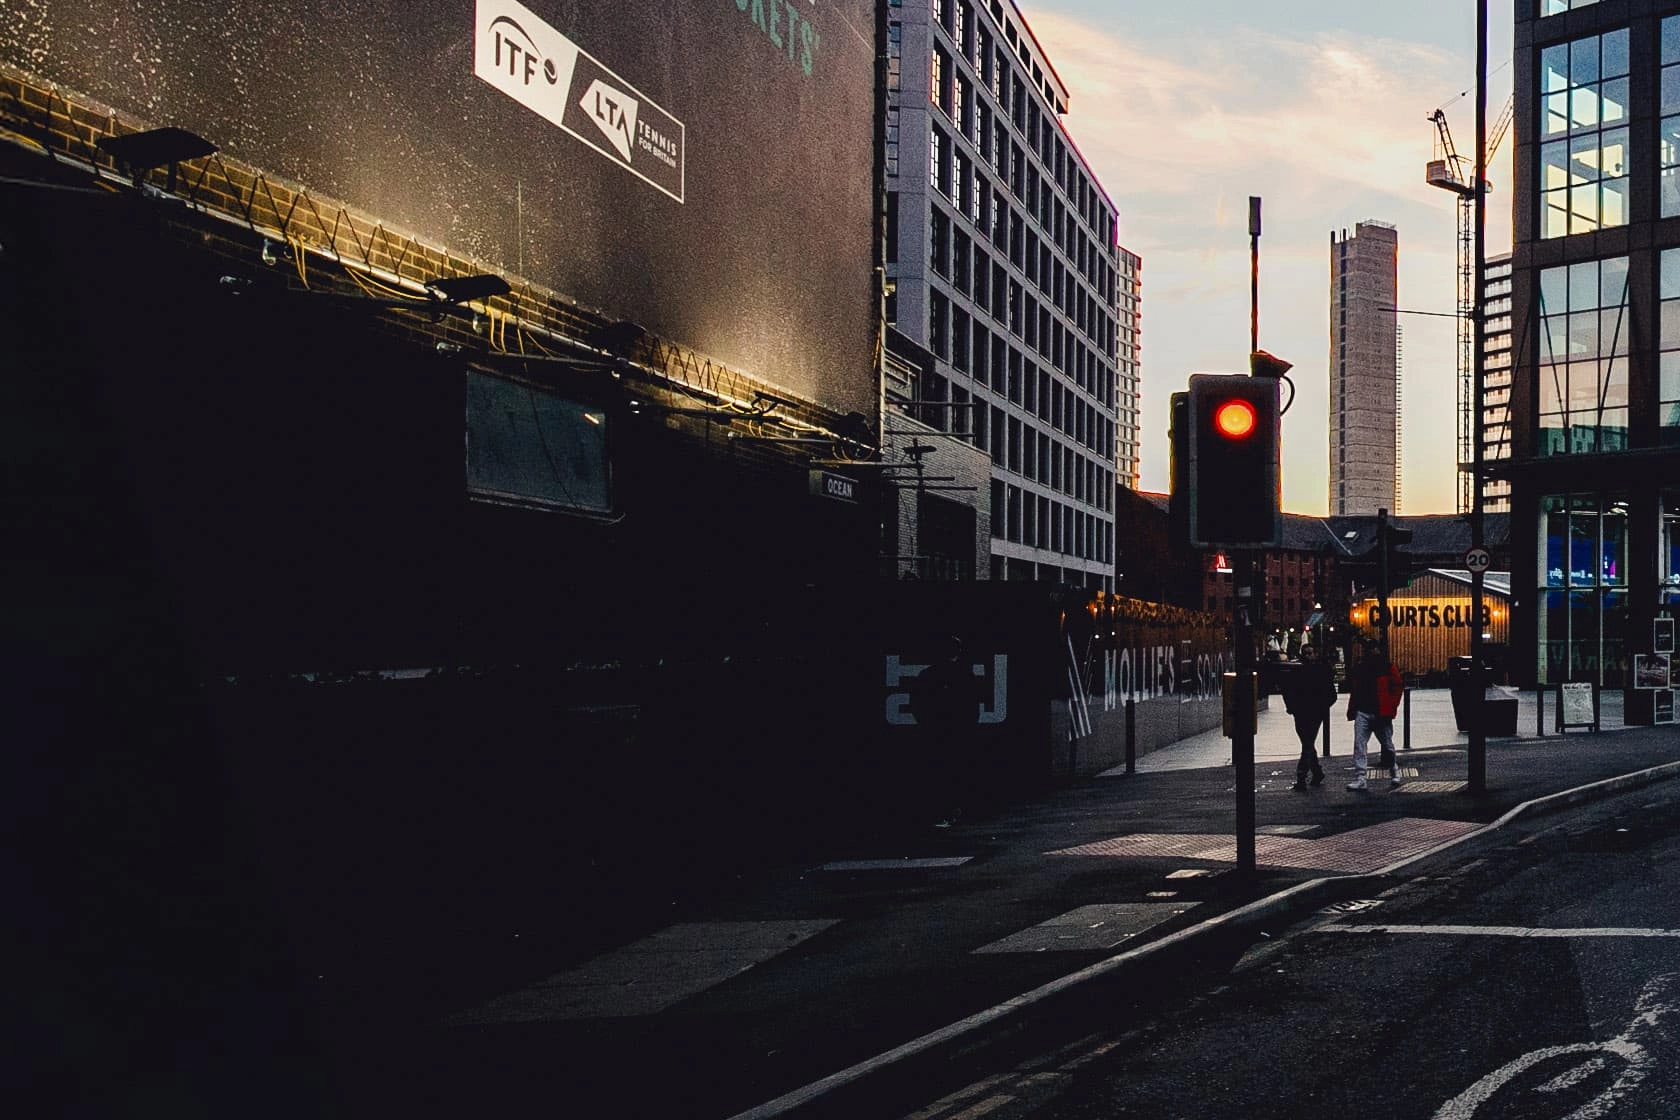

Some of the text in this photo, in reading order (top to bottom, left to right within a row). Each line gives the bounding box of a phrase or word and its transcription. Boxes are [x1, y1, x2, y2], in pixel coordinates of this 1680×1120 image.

[495, 30, 538, 86] ITF
[595, 90, 633, 143] LTA
[638, 119, 677, 157] TENNIS
[638, 136, 653, 153] FOR
[827, 478, 853, 499] OCEAN
[1468, 554, 1489, 567] 20
[1104, 645, 1175, 712] MOLLIE'S
[1197, 652, 1224, 702] SOHO
